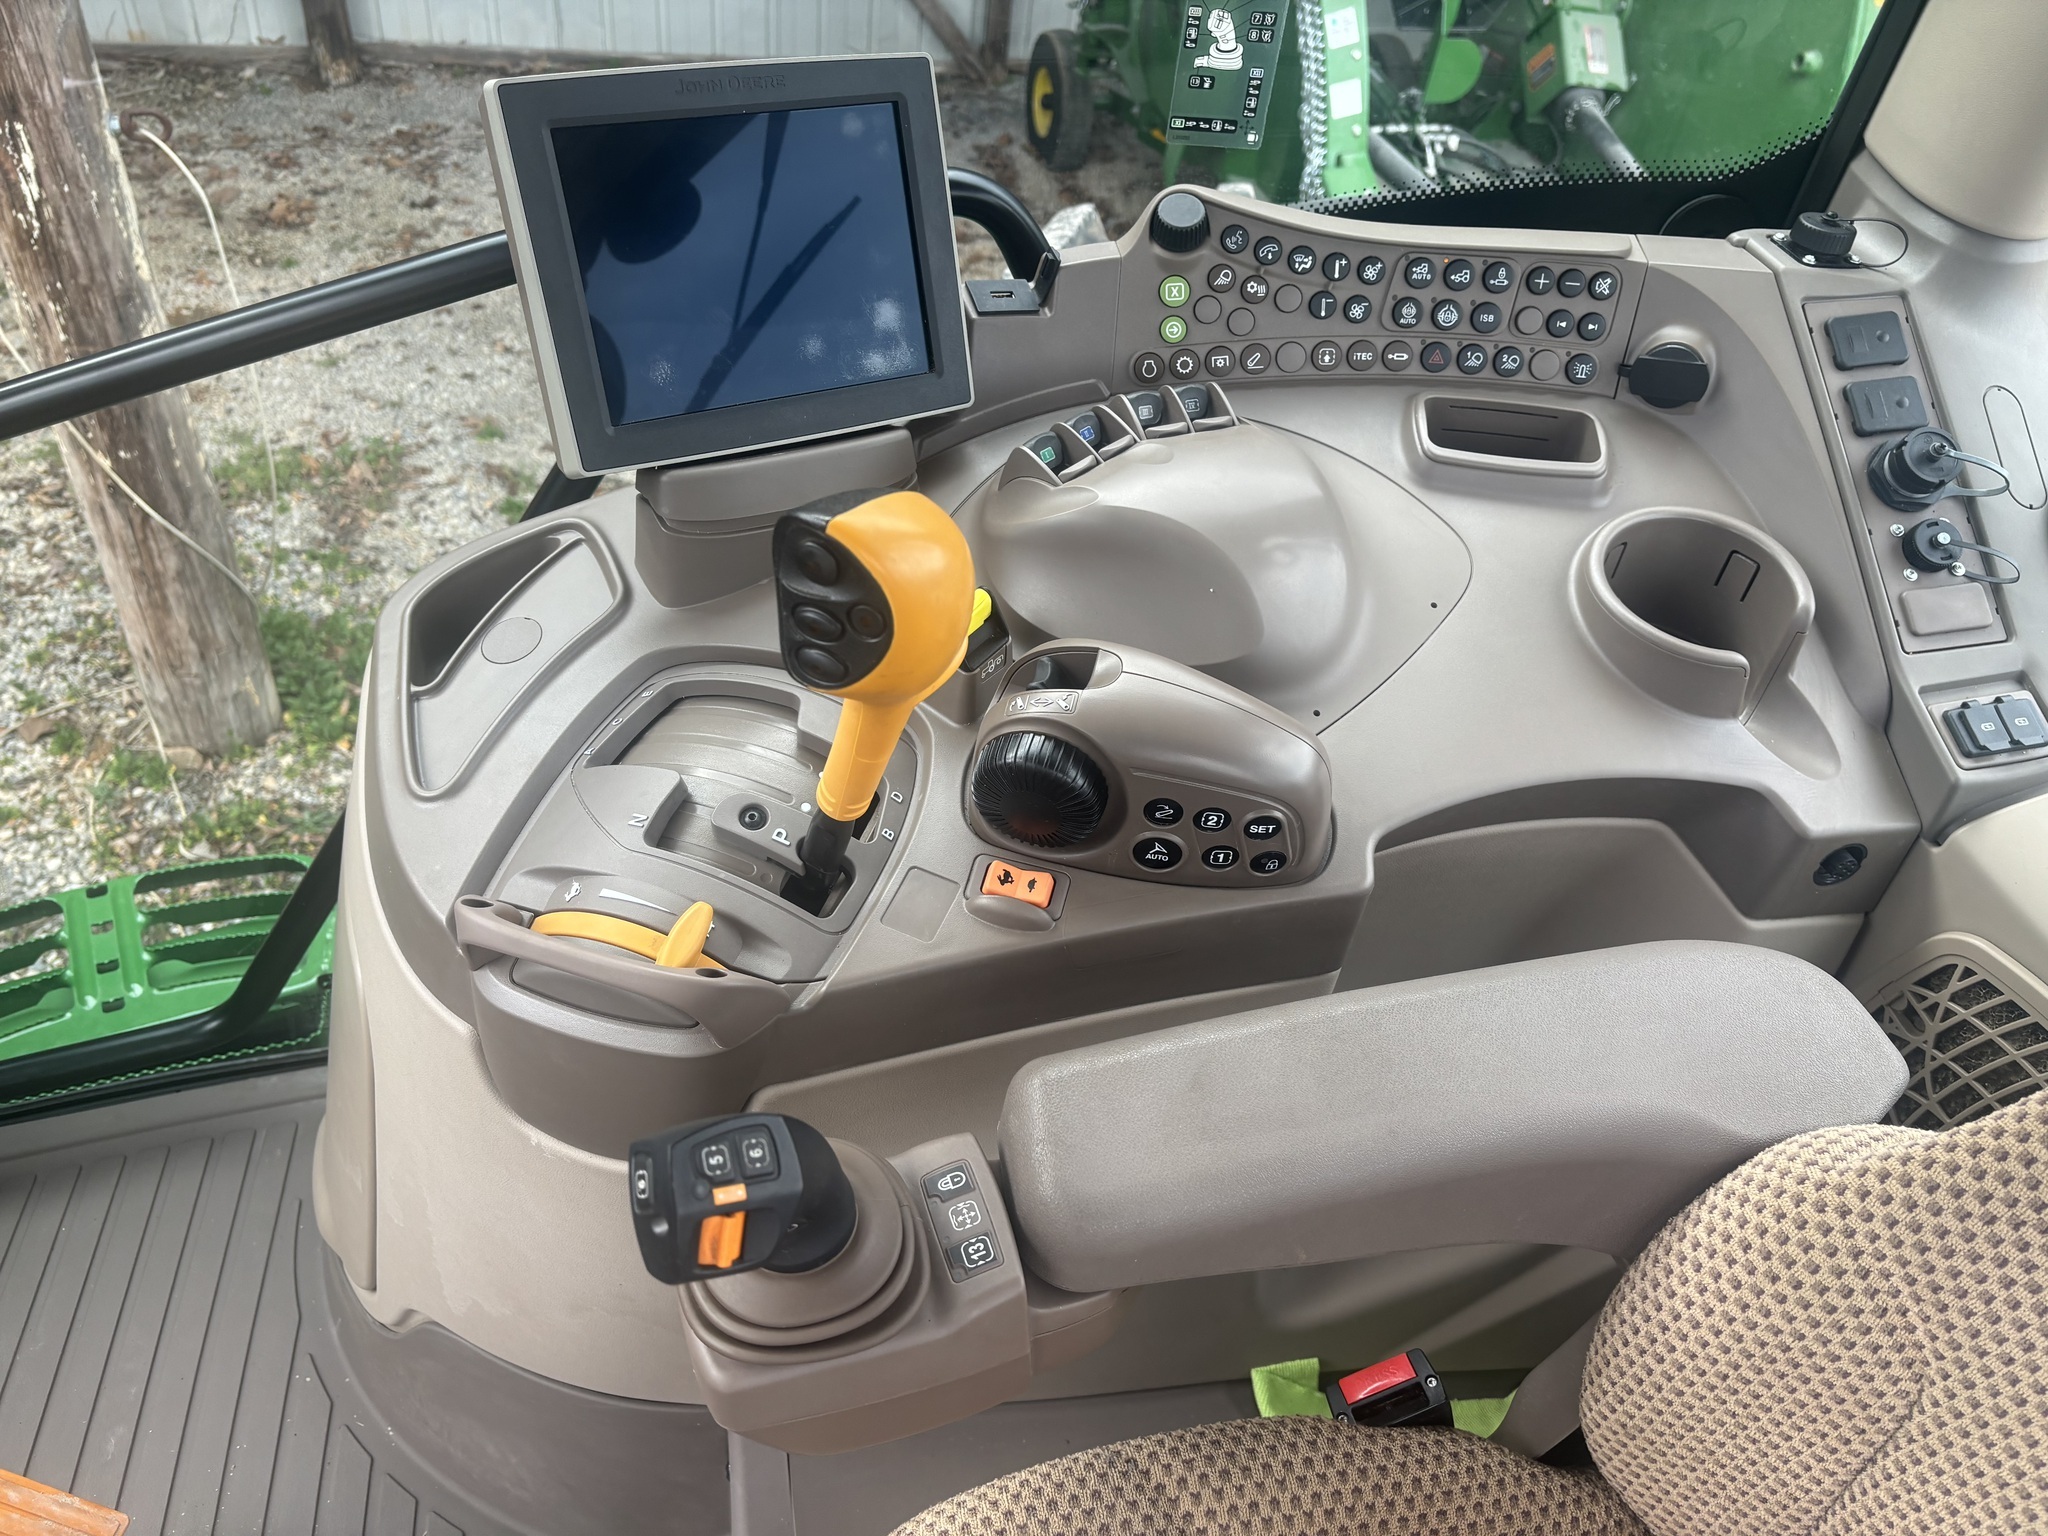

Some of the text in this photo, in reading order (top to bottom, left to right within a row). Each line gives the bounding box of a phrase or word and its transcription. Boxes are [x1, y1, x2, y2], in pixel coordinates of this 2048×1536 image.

[1253, 15, 1259, 23] 7
[675, 75, 786, 95] JOHN DEERE
[1170, 286, 1180, 298] X
[1480, 314, 1495, 323] ISB
[1353, 352, 1373, 361] iTEC
[641, 690, 654, 698] E
[612, 717, 624, 726] C
[890, 791, 903, 803] D
[628, 813, 649, 828] N
[1206, 815, 1218, 826] 2
[881, 828, 895, 841] B
[1249, 825, 1277, 834] SET
[772, 827, 791, 847] P
[1145, 853, 1169, 862] AUTO
[1217, 853, 1225, 863] 1
[708, 1154, 724, 1166] 5
[968, 1242, 987, 1261] 13
